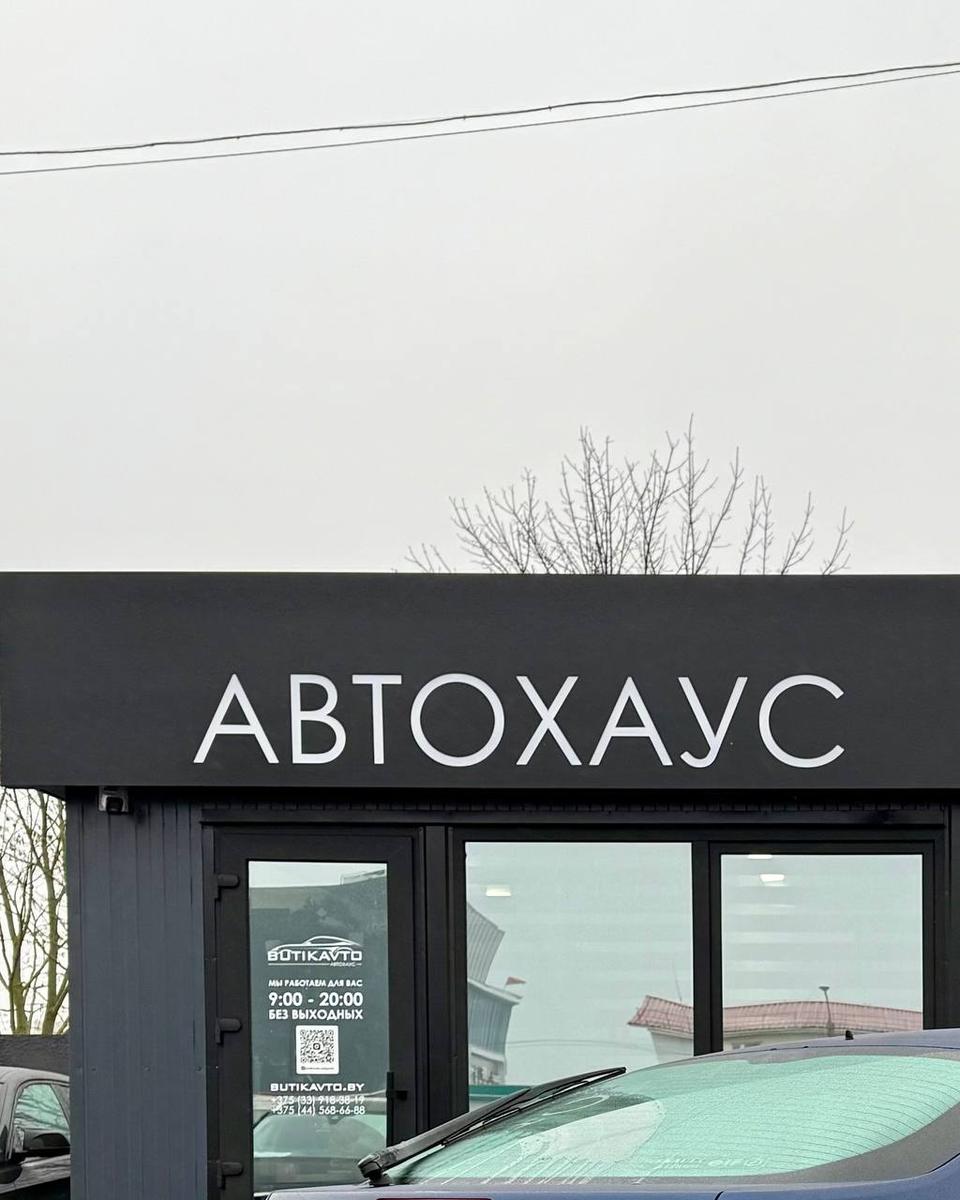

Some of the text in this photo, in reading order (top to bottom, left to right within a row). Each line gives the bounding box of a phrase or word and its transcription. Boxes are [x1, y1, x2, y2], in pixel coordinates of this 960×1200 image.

[193, 673, 845, 768] АВТОХАУС
[267, 950, 363, 961] BUTIKAVTO
[268, 979, 283, 987] МЫ
[327, 979, 344, 988] ДЛЯ
[345, 979, 363, 987] ВАС
[268, 992, 303, 1007] 9:00
[319, 992, 363, 1007] 20:00
[268, 1009, 363, 1021] БЕЗ ВЫХОДНЫХ
[270, 1083, 365, 1092] BUTIKAVTO.BY
[297, 1095, 316, 1106] (33)
[271, 1105, 366, 1116] +375 (44) 568-66-88
